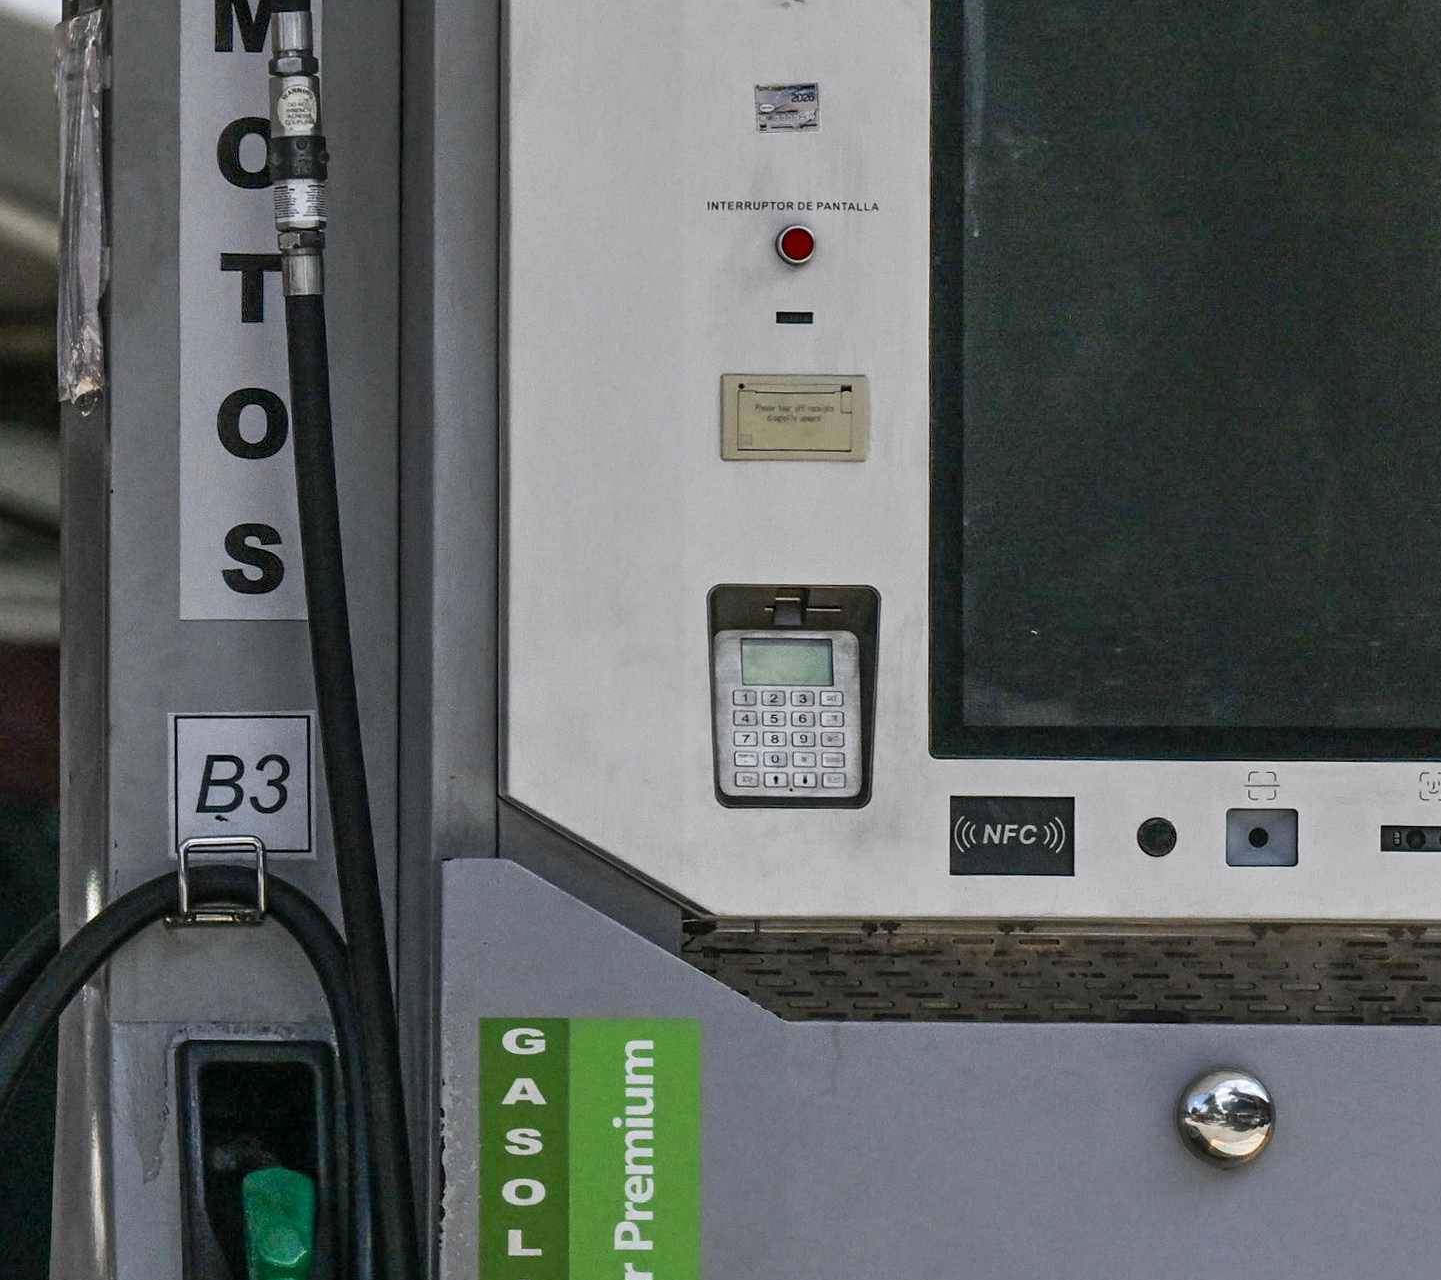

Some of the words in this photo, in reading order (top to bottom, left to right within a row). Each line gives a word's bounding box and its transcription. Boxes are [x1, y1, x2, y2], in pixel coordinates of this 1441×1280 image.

[707, 201, 794, 211] INTERRUPTOR
[797, 201, 813, 211] DE
[816, 201, 879, 212] PANTALLA
[742, 693, 748, 704] 1
[769, 693, 778, 704] 2
[799, 693, 808, 704] 3
[740, 714, 750, 723] 4
[770, 714, 778, 723] 5
[798, 714, 808, 723] 6
[742, 734, 750, 744] 7
[770, 734, 779, 744] 8
[799, 734, 808, 744] 9
[771, 754, 780, 764] 0
[197, 752, 291, 815] B3
[982, 823, 1038, 845] NFC
[612, 1039, 655, 1251] Premium
